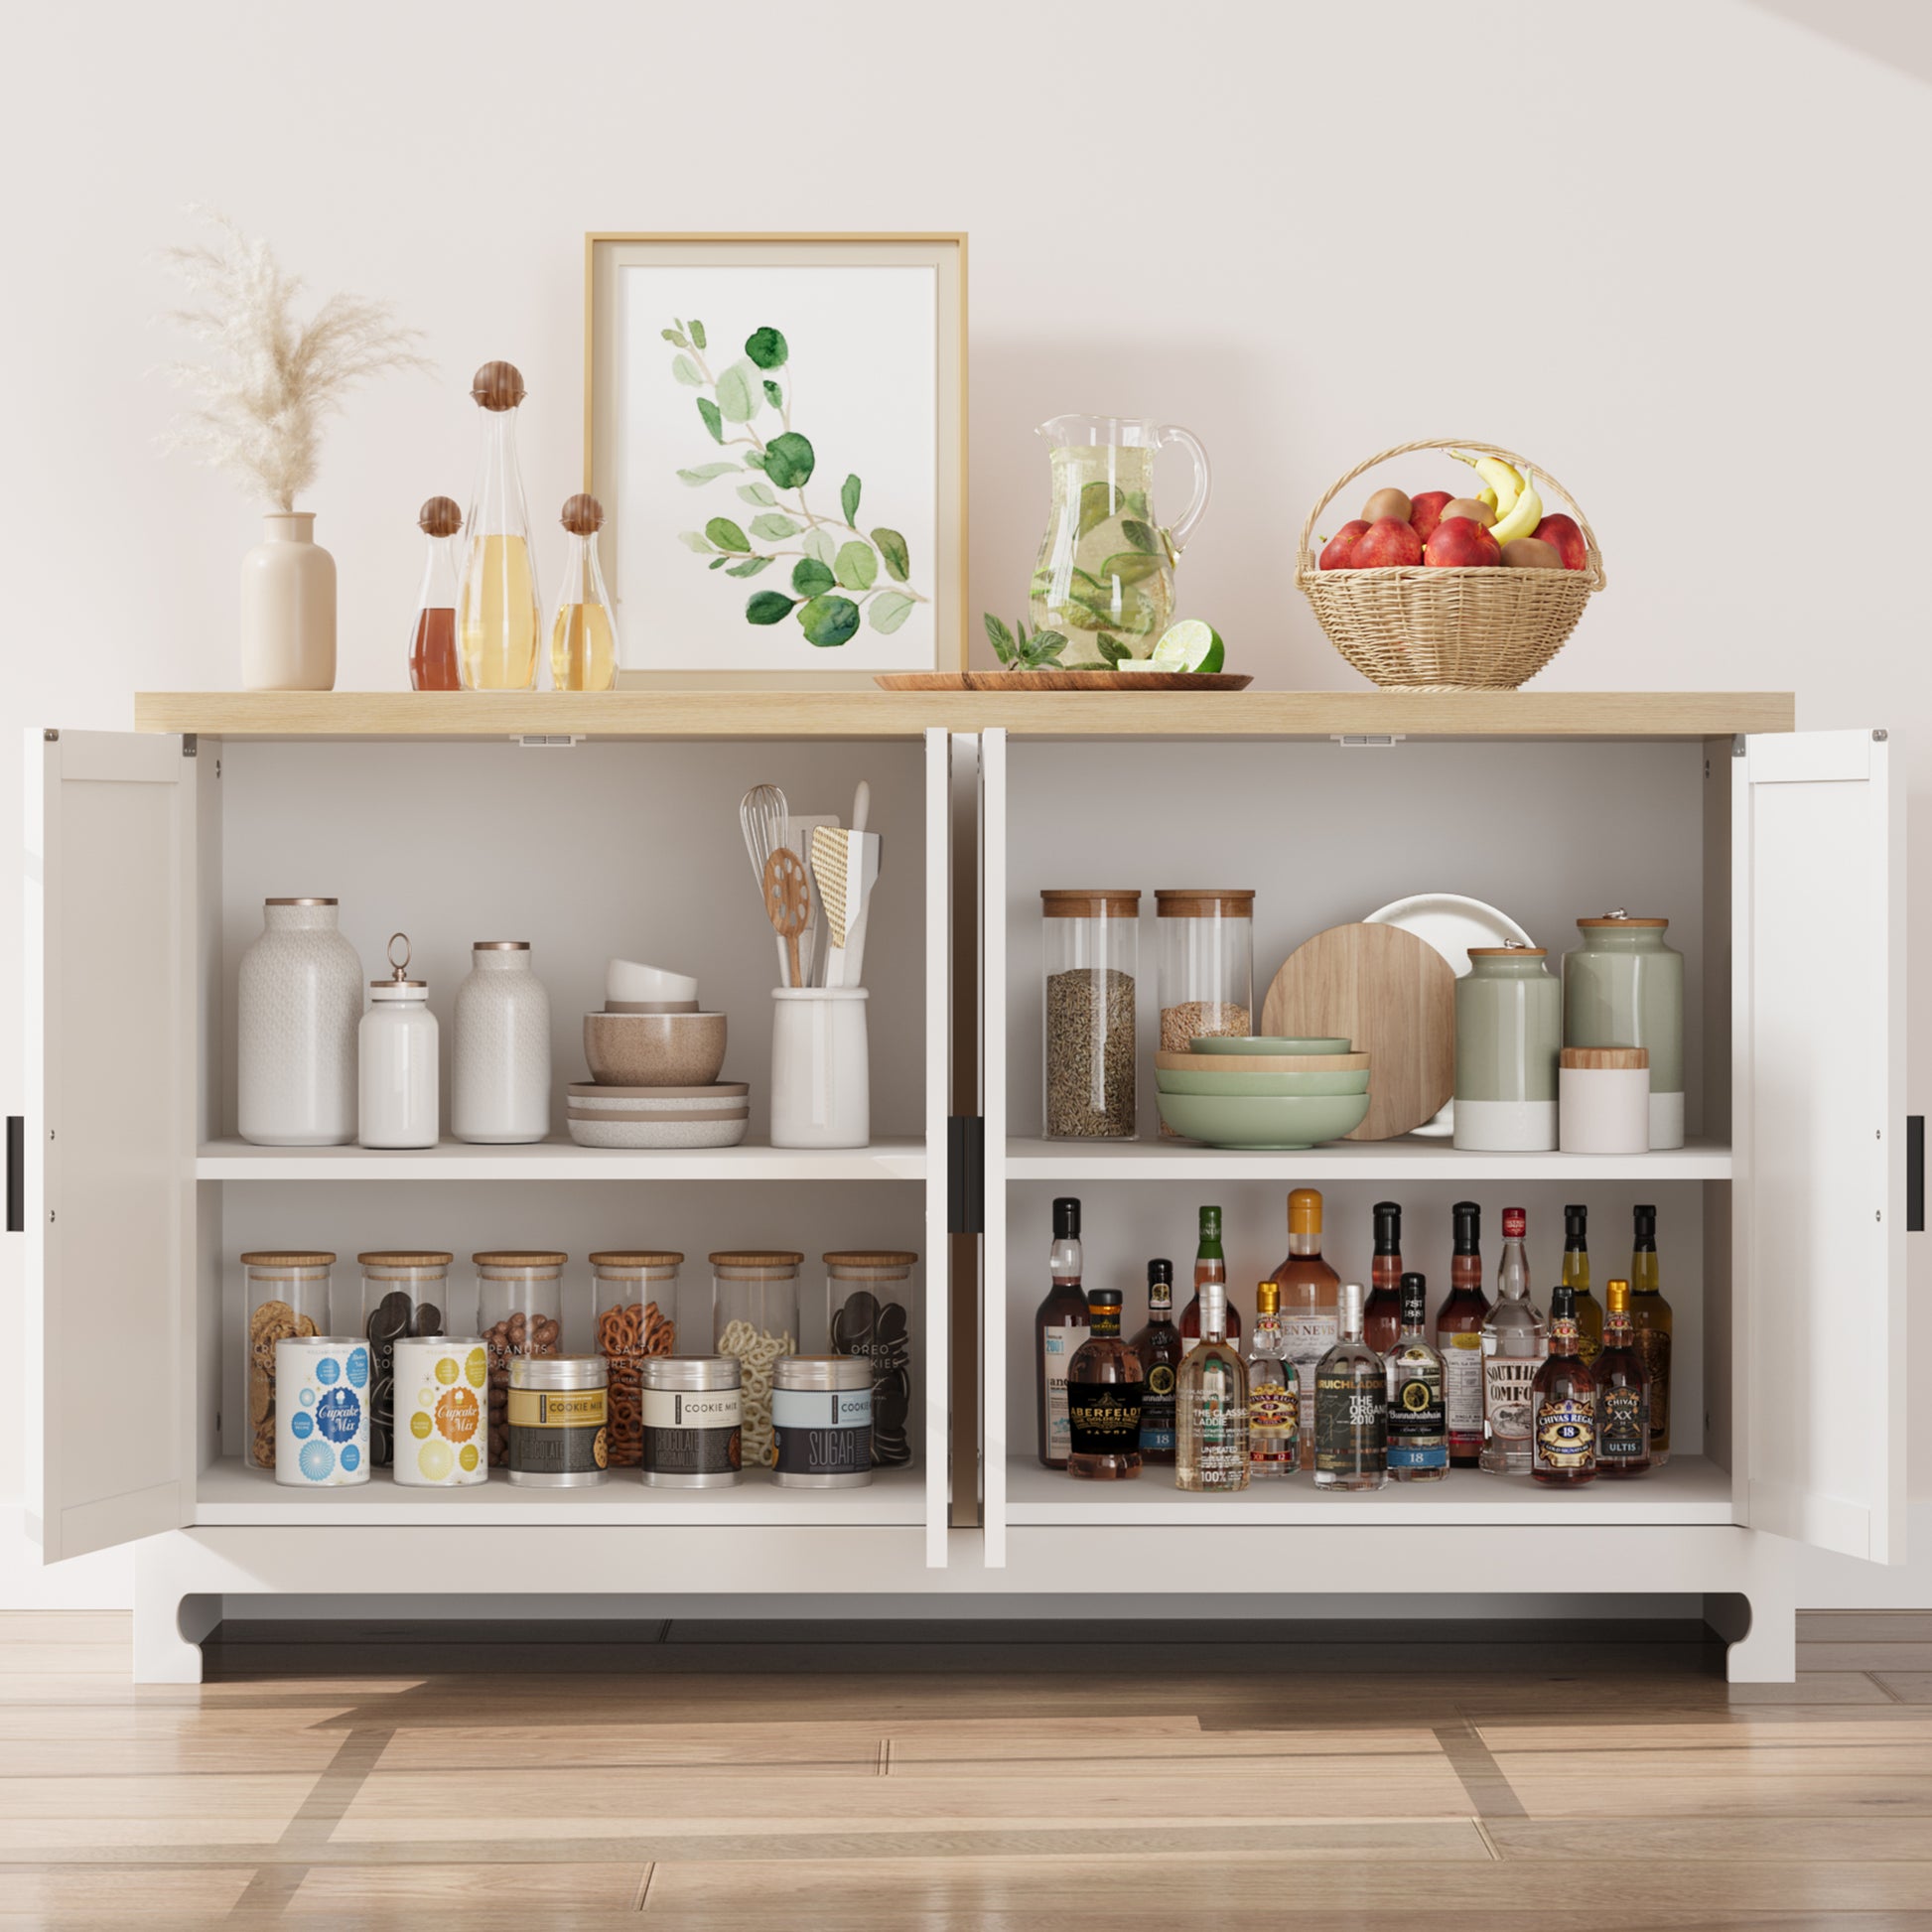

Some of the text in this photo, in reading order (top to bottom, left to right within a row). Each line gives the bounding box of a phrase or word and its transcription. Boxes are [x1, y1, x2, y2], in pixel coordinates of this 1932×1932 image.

[1283, 1324, 1335, 1335] EN NEVIS
[615, 1344, 654, 1356] SALTY
[851, 1344, 890, 1355] OREO
[870, 1358, 898, 1369] KIES
[1490, 1386, 1532, 1401] COMFO
[1348, 1395, 1373, 1406] THE
[549, 1401, 589, 1413] COOKIE
[684, 1401, 738, 1413] COOKIE MIX
[1071, 1407, 1142, 1417] ABERFELDY
[319, 1404, 359, 1422] Cupcake
[438, 1404, 478, 1422] Cupcake
[1193, 1409, 1212, 1418] THE
[1614, 1410, 1632, 1421] XX
[331, 1417, 355, 1433] Mix
[450, 1417, 474, 1433] Mix
[1193, 1418, 1227, 1427] LADDIE
[1349, 1414, 1375, 1426] 2010
[1539, 1413, 1569, 1426] CHIVAS
[1563, 1427, 1575, 1438] 18
[1155, 1435, 1171, 1445] 18
[809, 1430, 855, 1466] SUGAR
[1609, 1443, 1636, 1452] ULTIS
[1410, 1452, 1424, 1463] 18
[1200, 1470, 1227, 1482] 100%
